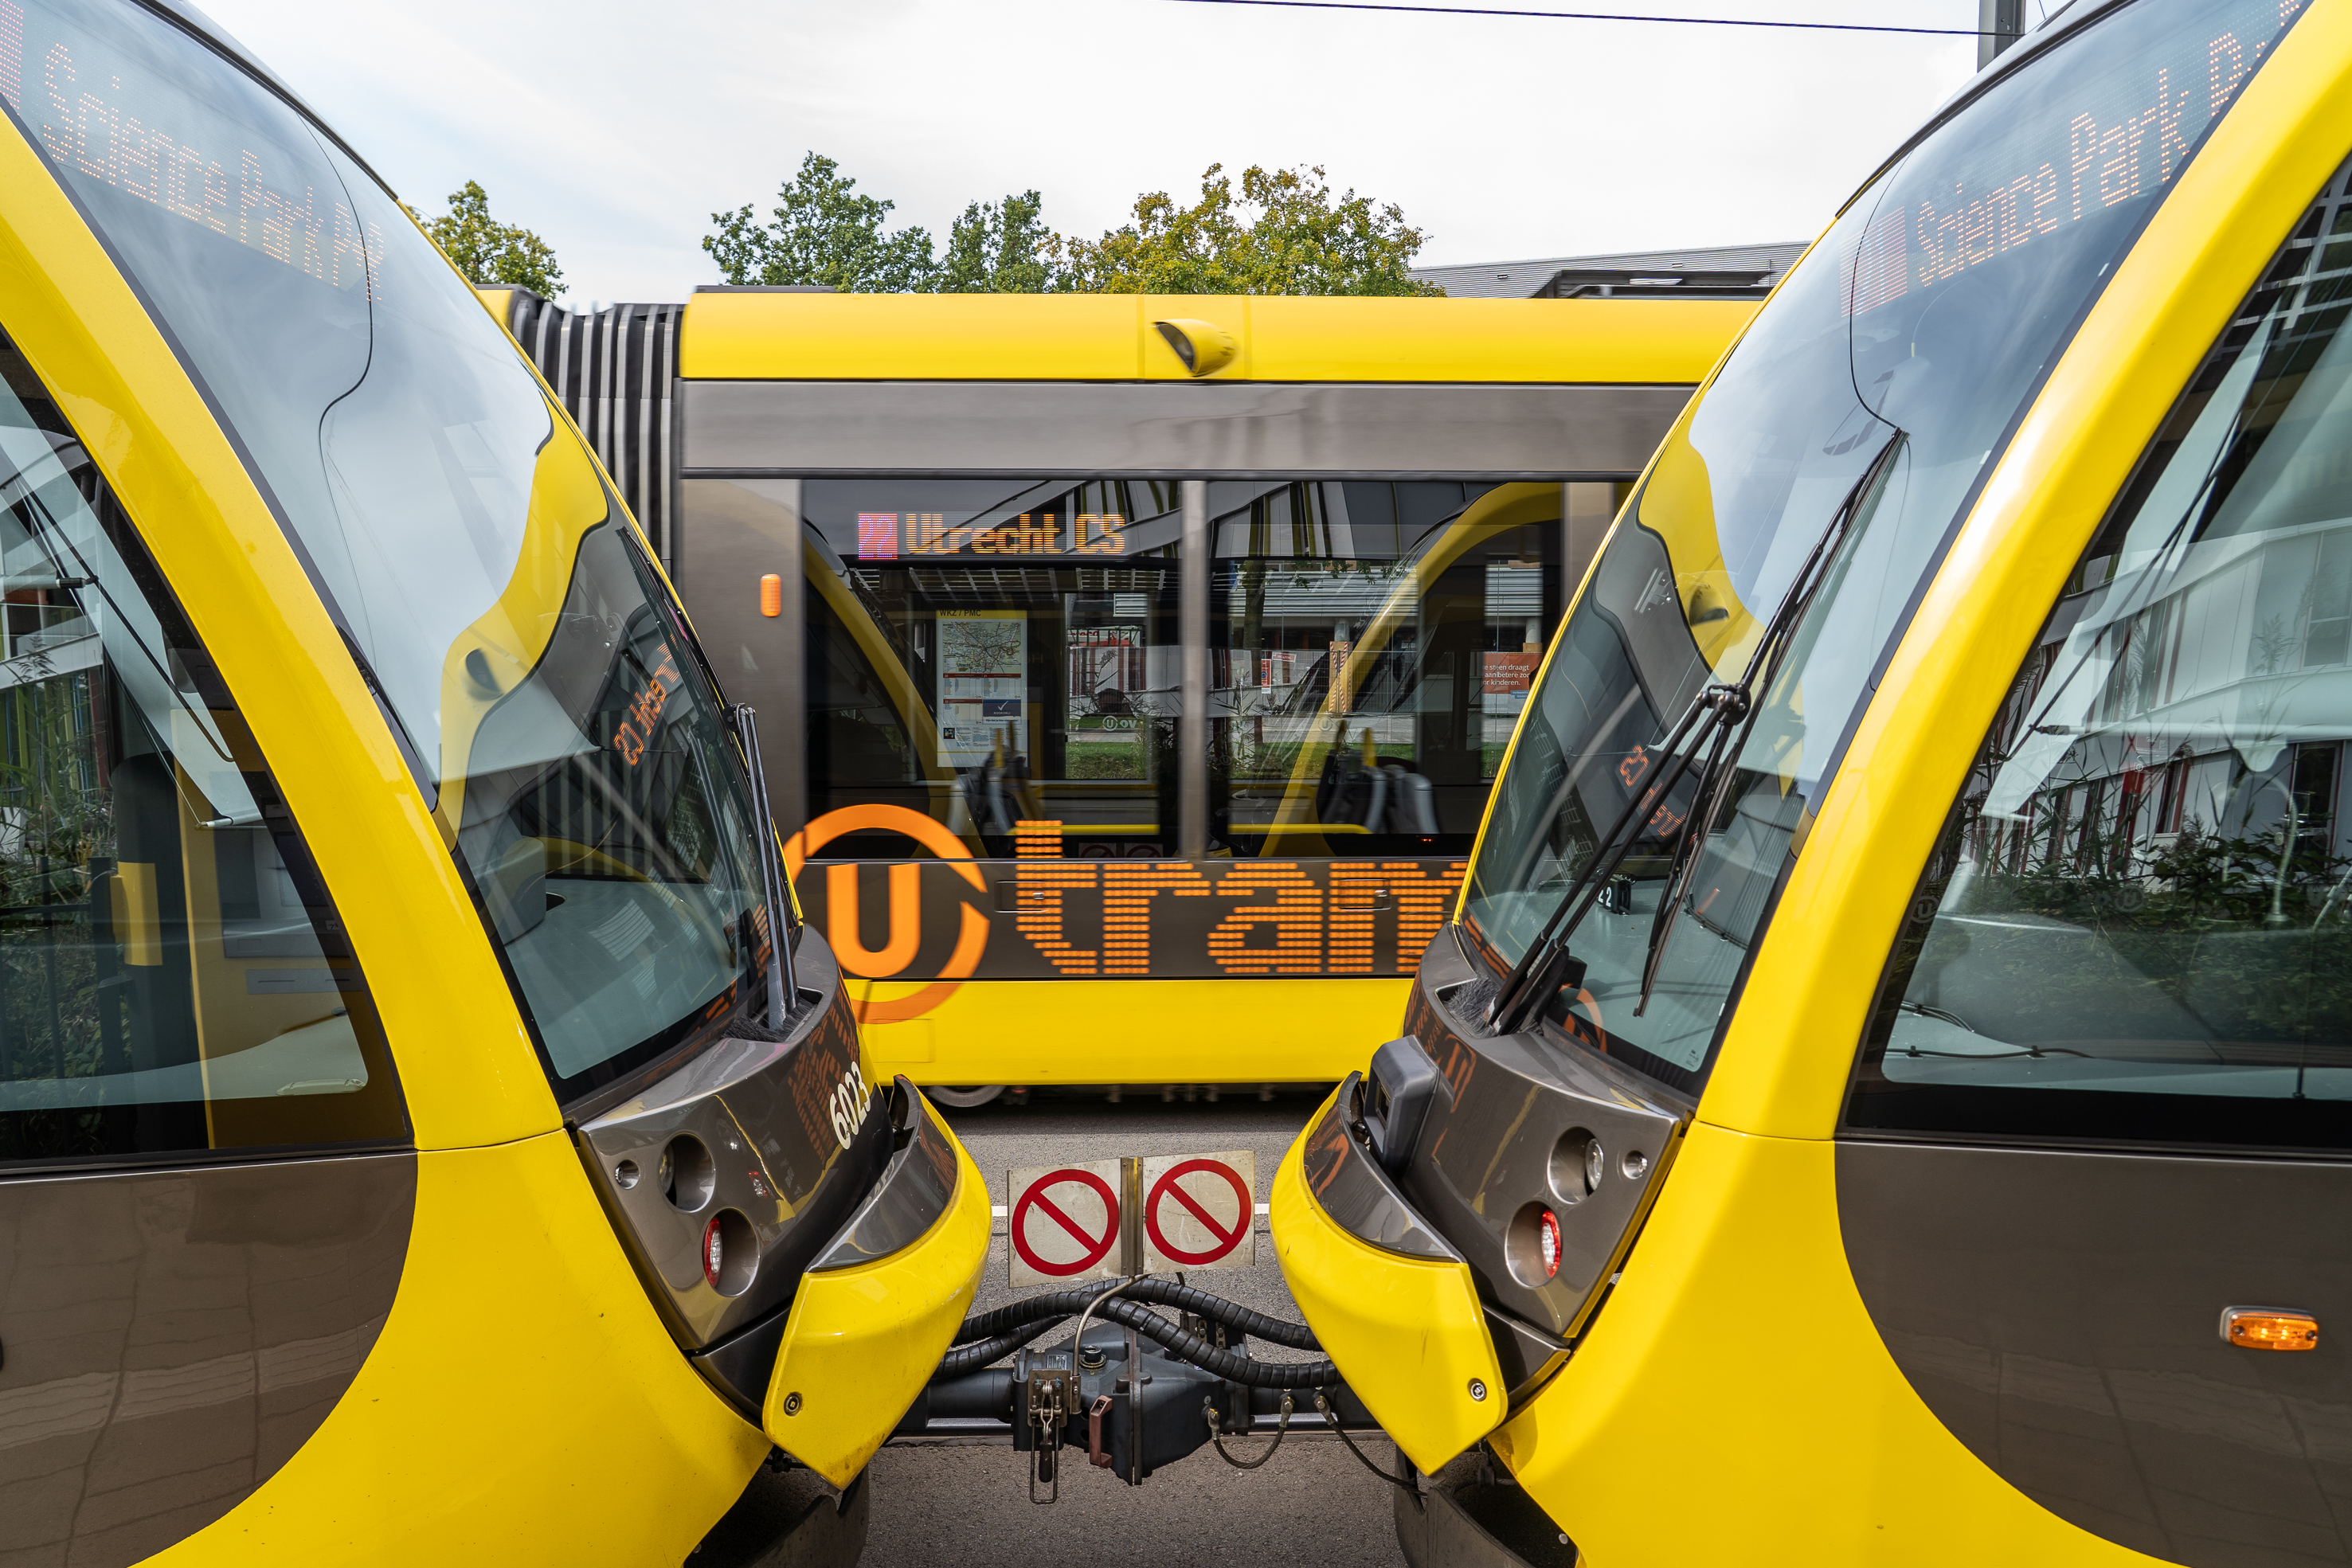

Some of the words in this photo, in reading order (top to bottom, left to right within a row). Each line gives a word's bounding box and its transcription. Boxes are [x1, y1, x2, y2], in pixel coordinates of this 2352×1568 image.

[42, 42, 228, 235] Science
[241, 149, 324, 280] Park
[1918, 162, 2059, 287] Science
[2070, 68, 2191, 221] Park
[859, 514, 894, 559] 22
[906, 513, 1062, 554] Utrecht
[1075, 513, 1126, 554] CS
[830, 1061, 871, 1150] 6023
